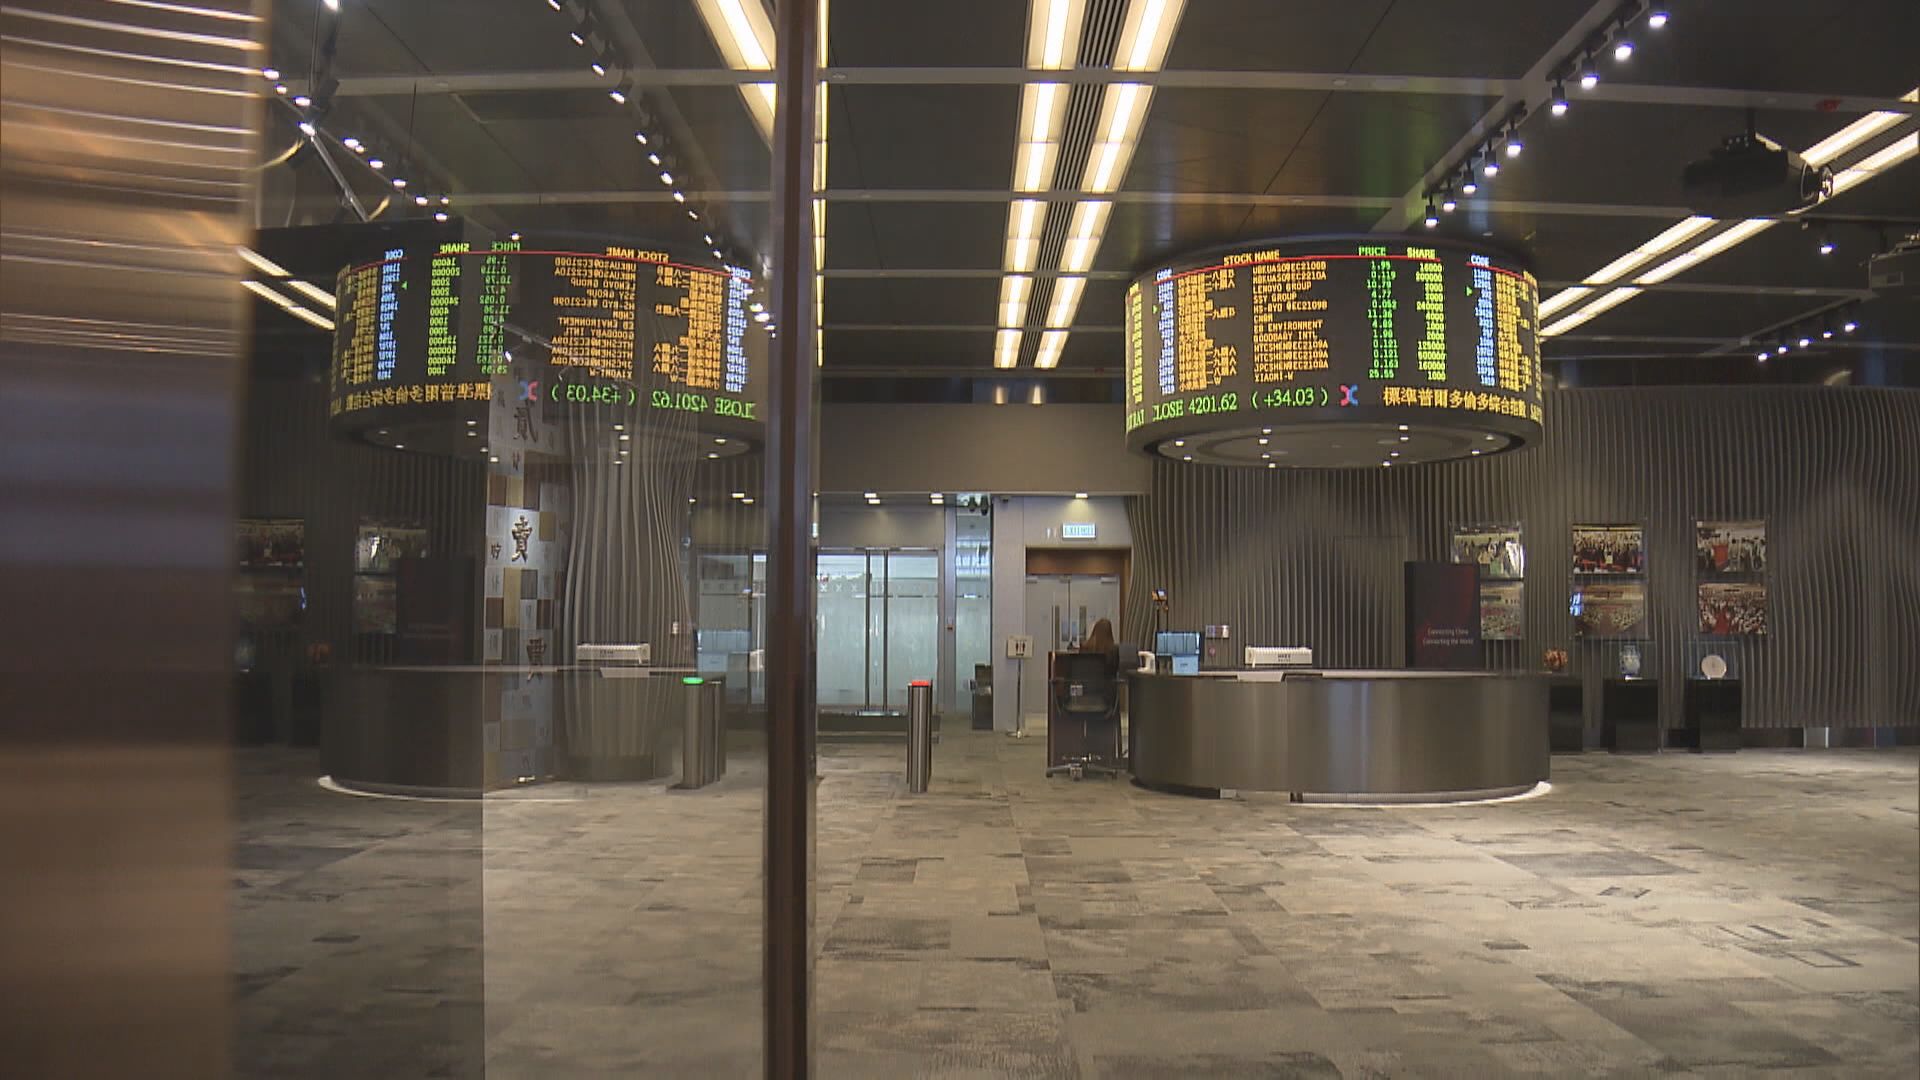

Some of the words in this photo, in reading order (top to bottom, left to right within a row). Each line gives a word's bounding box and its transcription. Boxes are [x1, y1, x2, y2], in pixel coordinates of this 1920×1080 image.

[1358, 246, 1386, 256] PRICE
[1407, 247, 1435, 259] SHARE
[1224, 253, 1251, 266] STOCK
[1254, 250, 1280, 261] NAME
[1471, 255, 1489, 268] CODE
[1253, 283, 1282, 294] LENOVO
[1286, 280, 1312, 292] GROUP
[1272, 292, 1297, 302] GROUP
[1372, 290, 1392, 298] 4.77
[1268, 319, 1323, 332] ENVIRONMENT
[1298, 330, 1318, 340] INTL
[1374, 340, 1398, 348] 0.121
[1374, 350, 1398, 358] 0.121
[1254, 371, 1294, 382] XIAOMI-W
[1188, 392, 1238, 414] 4201.62
[1264, 388, 1314, 406] +34.03
